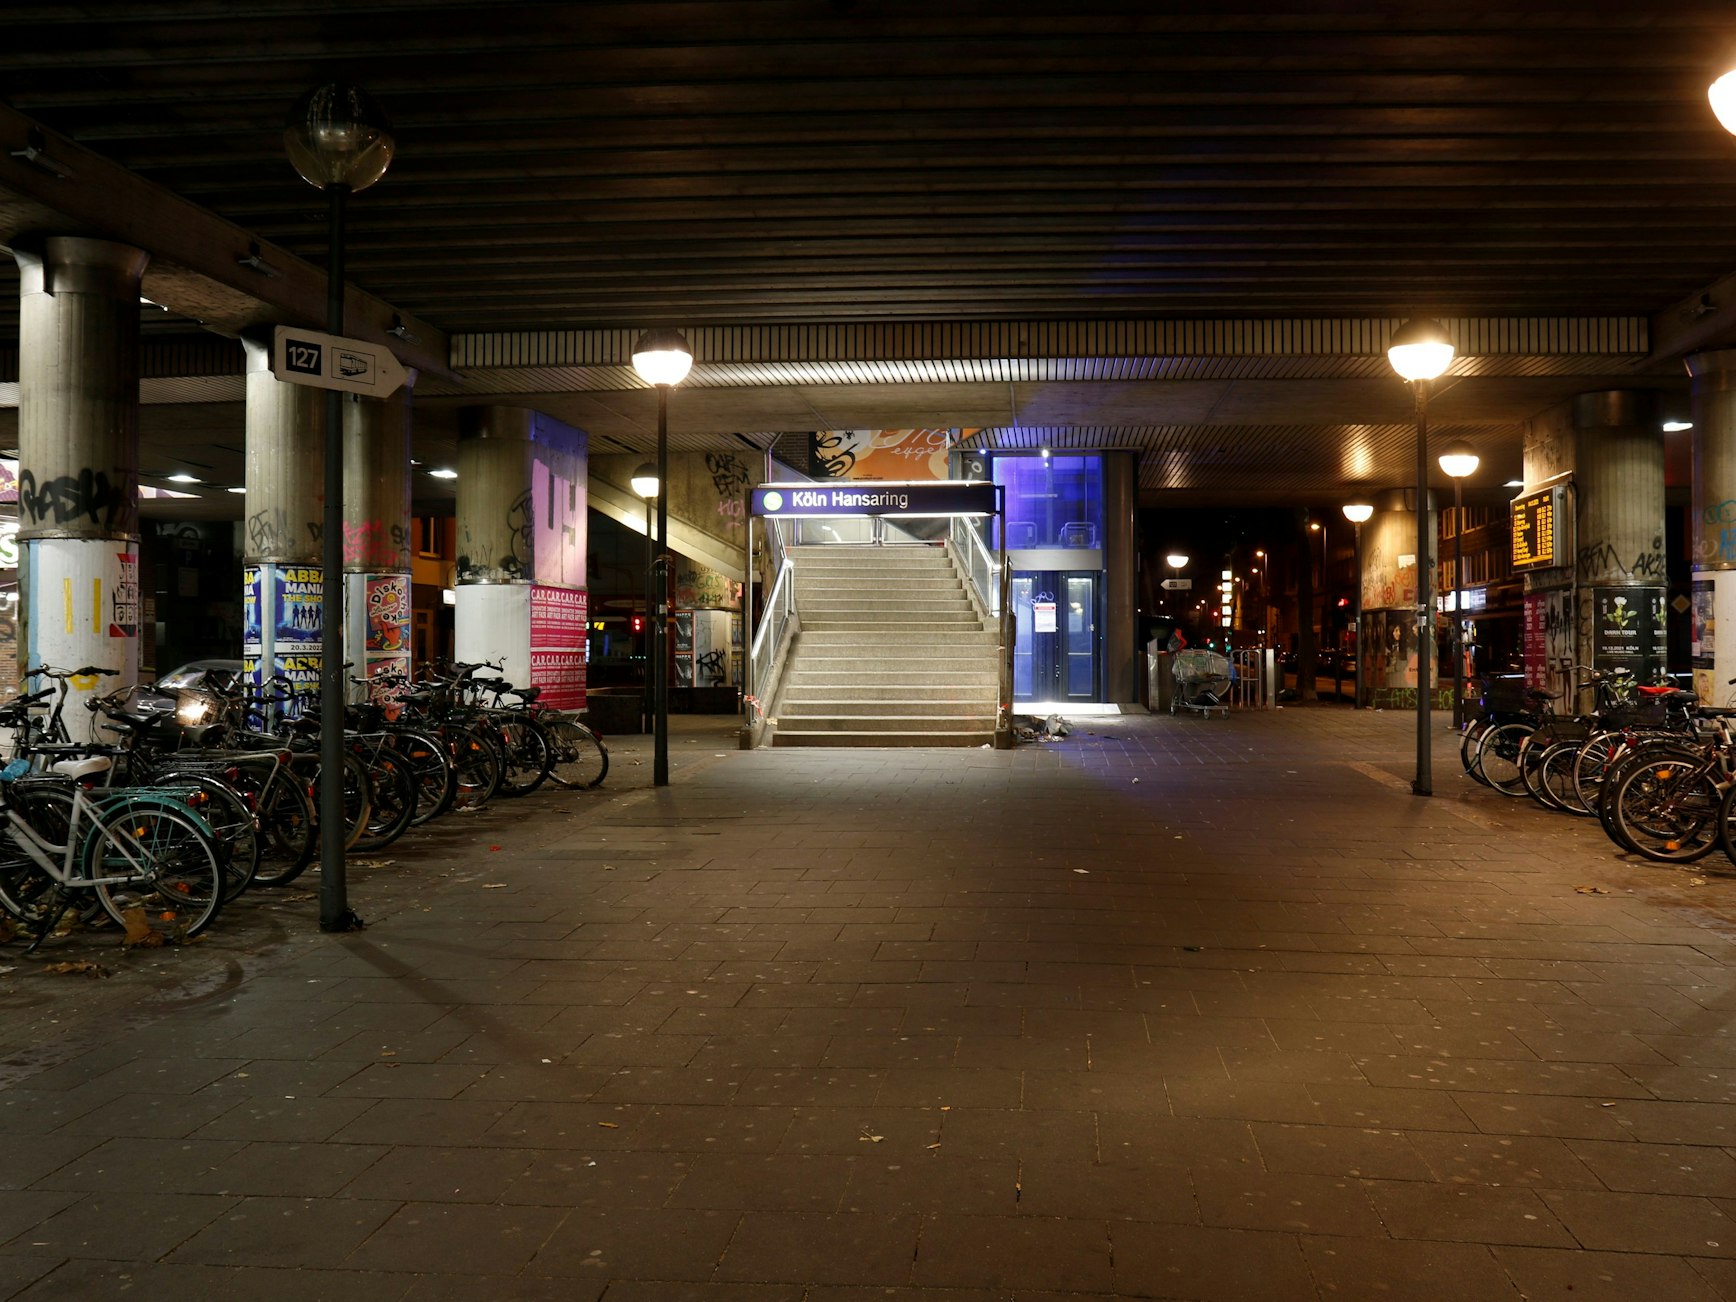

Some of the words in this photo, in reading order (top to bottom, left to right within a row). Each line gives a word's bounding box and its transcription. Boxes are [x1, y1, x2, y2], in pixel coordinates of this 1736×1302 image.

[288, 346, 319, 369] 127
[792, 491, 828, 507] Köln
[832, 491, 909, 509] Hansaring
[285, 569, 323, 583] ABB
[282, 594, 303, 603] THE
[304, 594, 323, 604] SHO
[285, 671, 321, 682] MANI
